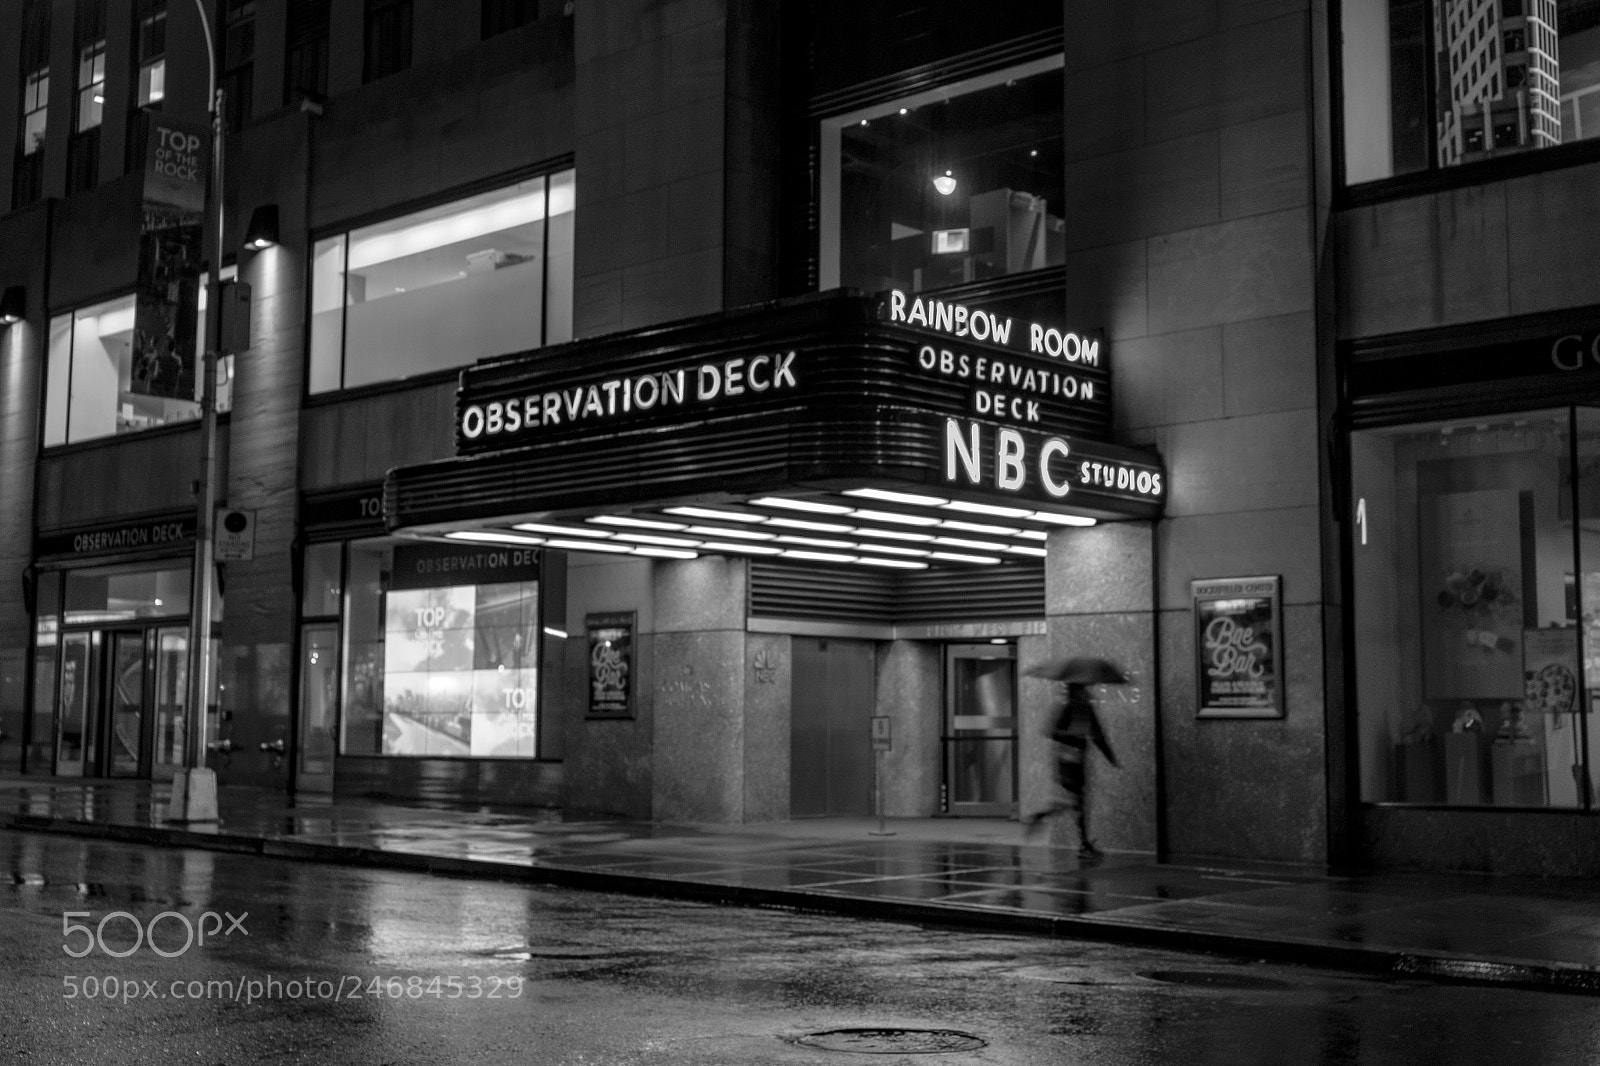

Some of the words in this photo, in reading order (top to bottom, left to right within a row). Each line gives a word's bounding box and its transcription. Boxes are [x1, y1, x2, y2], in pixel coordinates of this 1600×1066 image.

[157, 126, 200, 153] TOP
[155, 160, 198, 182] ROCK
[156, 148, 172, 160] OF
[175, 152, 198, 167] THE
[891, 289, 1012, 344] RAINBOW
[1030, 322, 1099, 367] ROOM
[1551, 332, 1600, 371] G
[919, 345, 1094, 400] OBSERVATION
[462, 369, 685, 439] OBSERVATION
[697, 350, 796, 401] DECK
[974, 390, 1040, 422] DECK
[946, 417, 1070, 498] NBC
[1081, 461, 1161, 495] STUDIOS
[359, 496, 384, 517] TO
[73, 527, 148, 552] OBSERVATION
[152, 521, 184, 543] DECK
[416, 551, 508, 573] OBSERVATION
[415, 607, 445, 627] TOP
[1205, 616, 1267, 653] Bae
[1207, 645, 1265, 678] Bar
